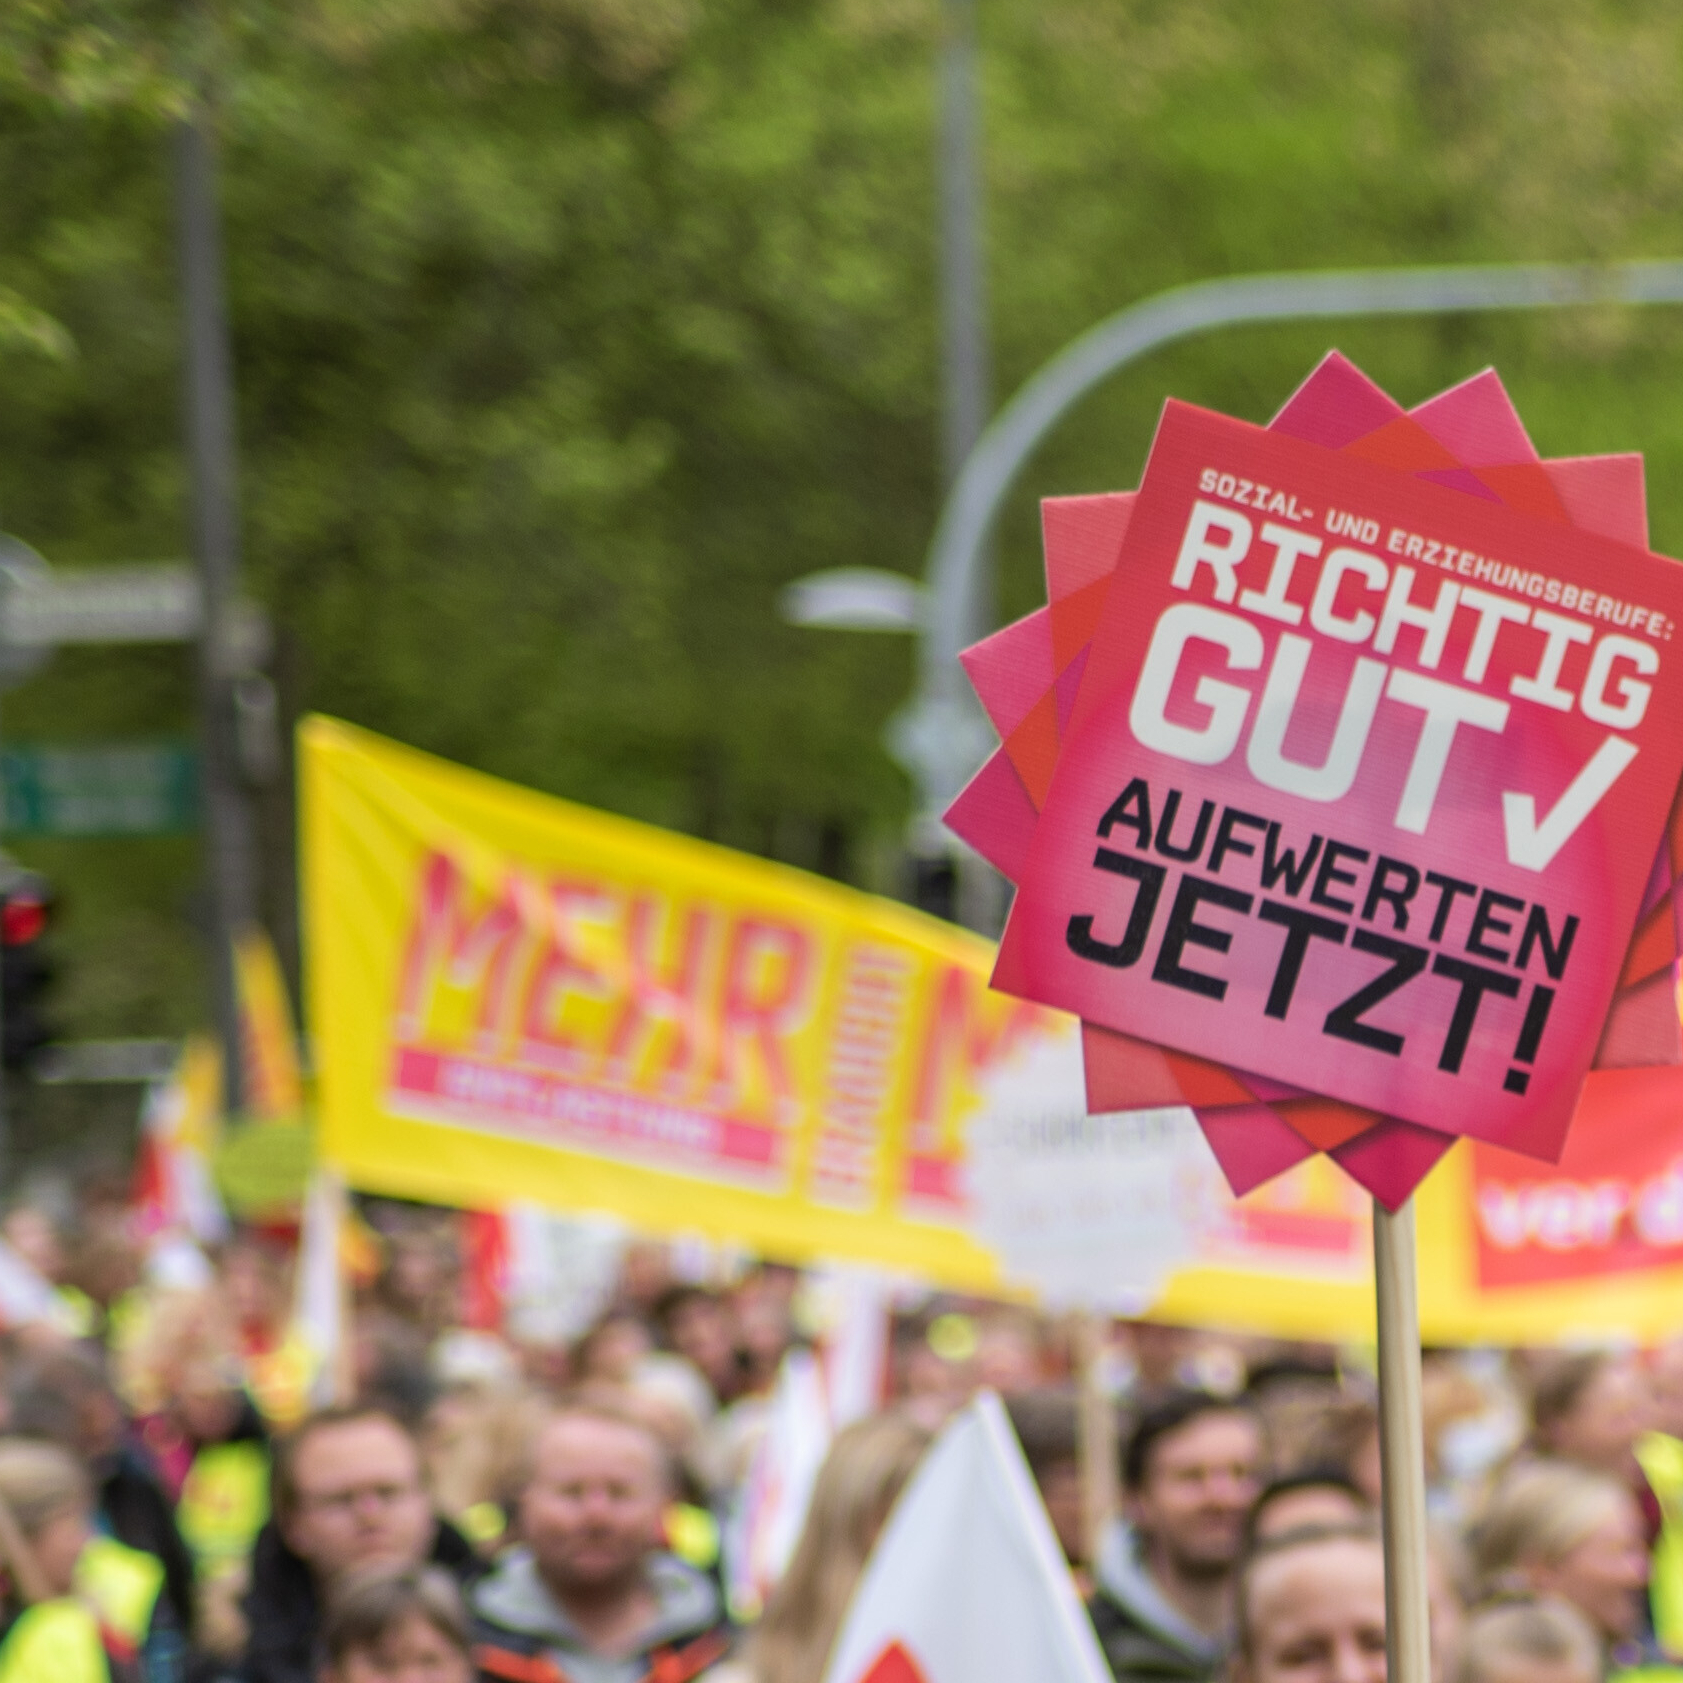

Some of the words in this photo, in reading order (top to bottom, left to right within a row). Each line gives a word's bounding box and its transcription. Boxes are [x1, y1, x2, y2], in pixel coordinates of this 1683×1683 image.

[1170, 500, 1660, 731] RICHTIG
[1200, 469, 1314, 522] SOZIAL-
[1326, 507, 1381, 544] UND
[1388, 528, 1675, 641] ERZIEHUNGSBERUFE:
[1129, 602, 1511, 836] GUT
[1065, 847, 1555, 1097] JETZT!
[1096, 777, 1580, 981] AUFWERTEN
